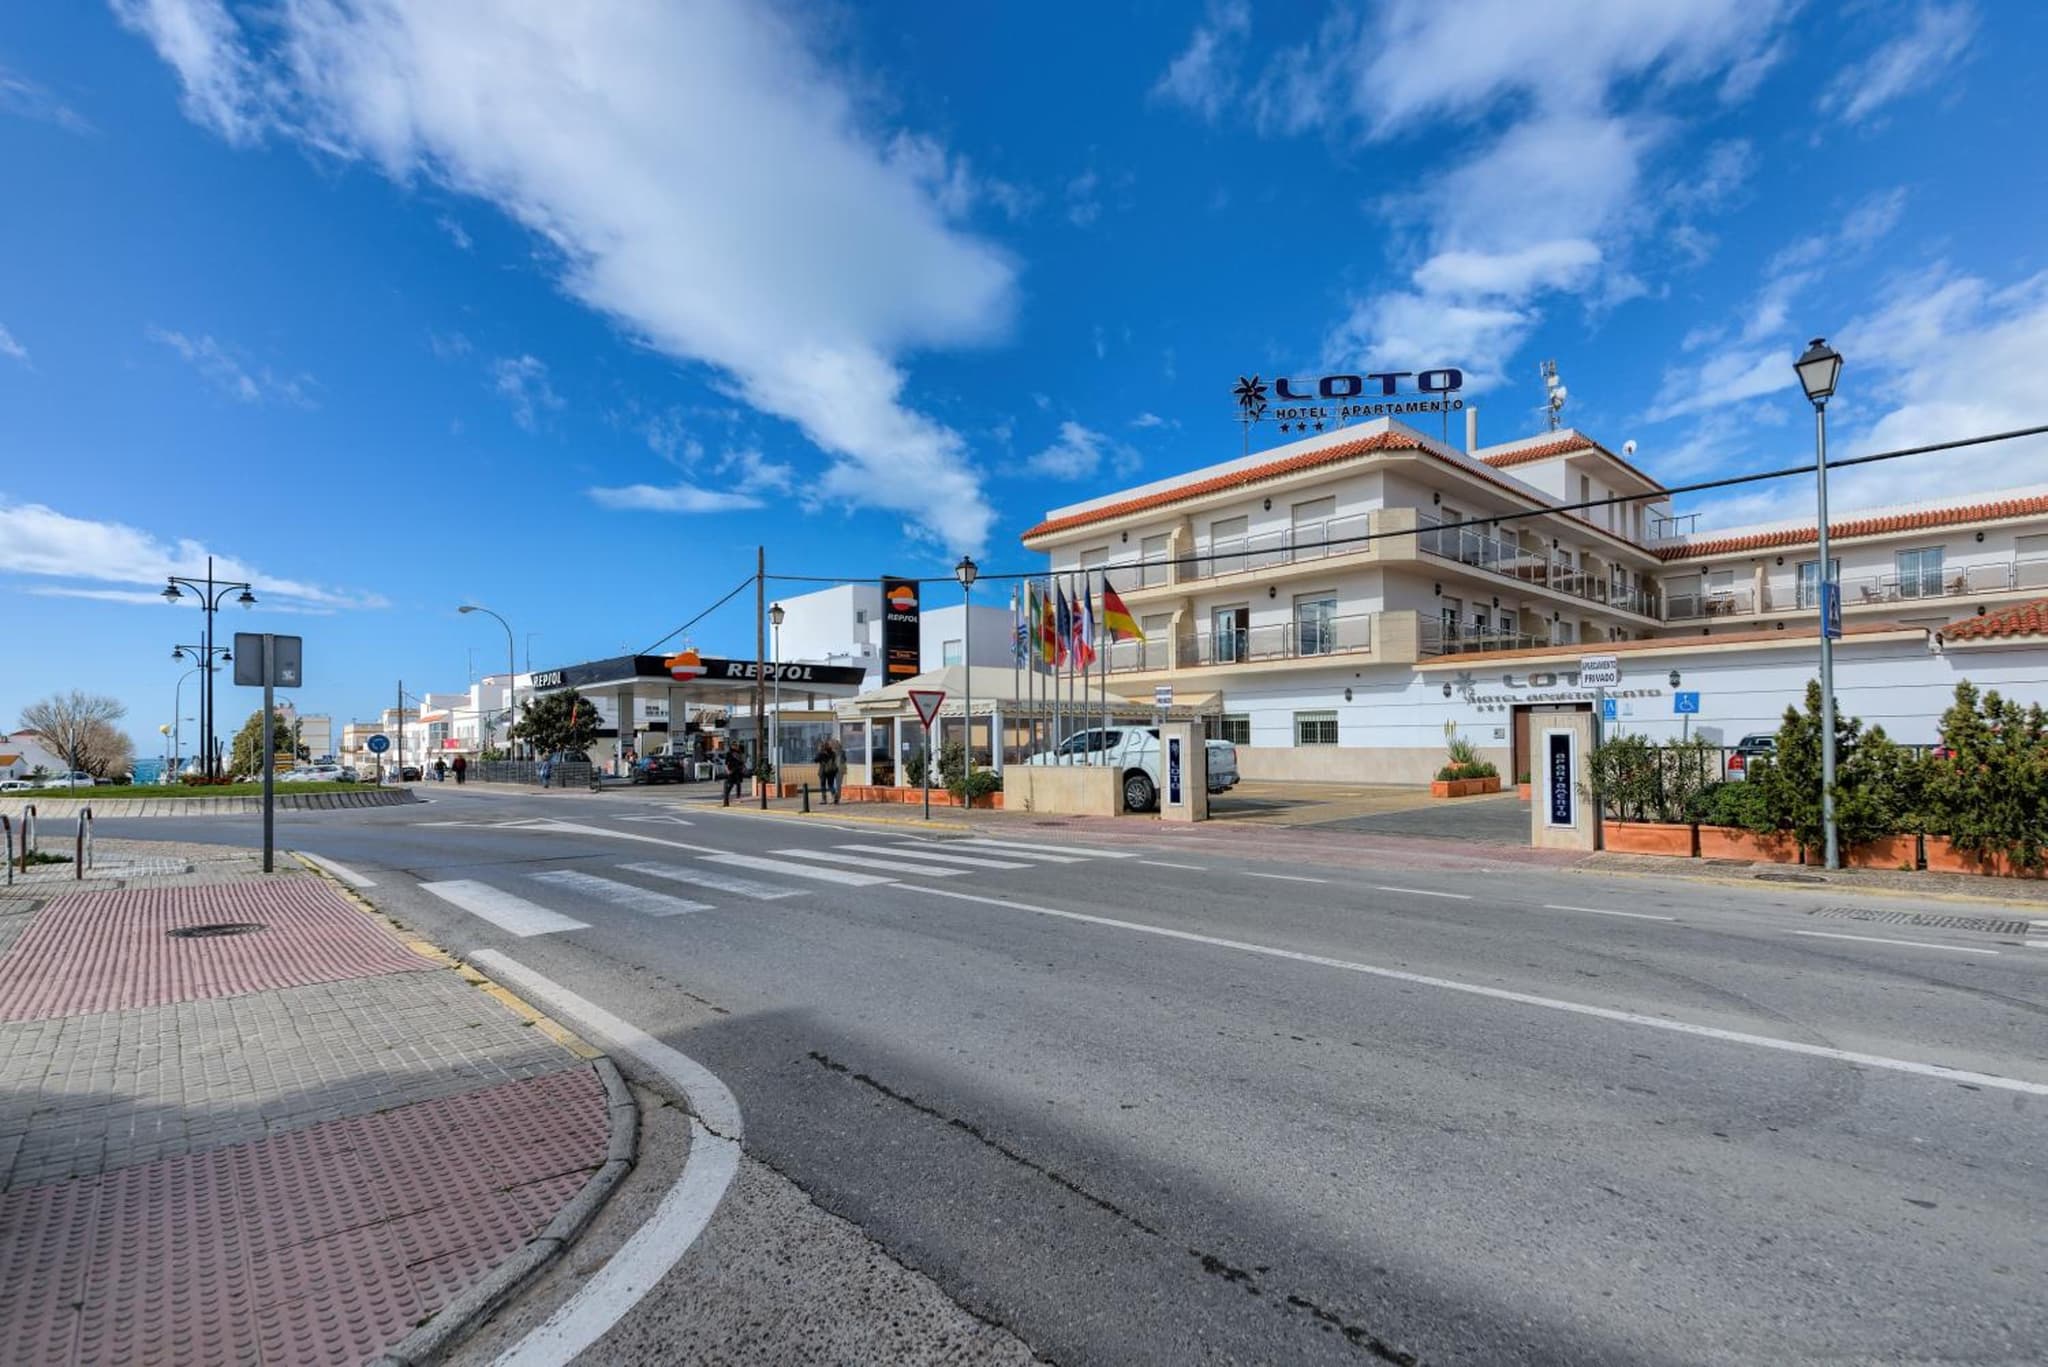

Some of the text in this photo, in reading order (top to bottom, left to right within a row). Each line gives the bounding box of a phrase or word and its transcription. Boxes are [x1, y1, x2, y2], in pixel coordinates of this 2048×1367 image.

[1276, 369, 1463, 399] LOTO
[1276, 400, 1463, 419] HOTEL APARTAMENTO
[887, 613, 918, 622] REPSOL
[533, 671, 561, 688] REPSOL
[727, 663, 813, 680] REPSOL
[1584, 673, 1615, 683] PRIVADO
[1502, 672, 1622, 689] LOT
